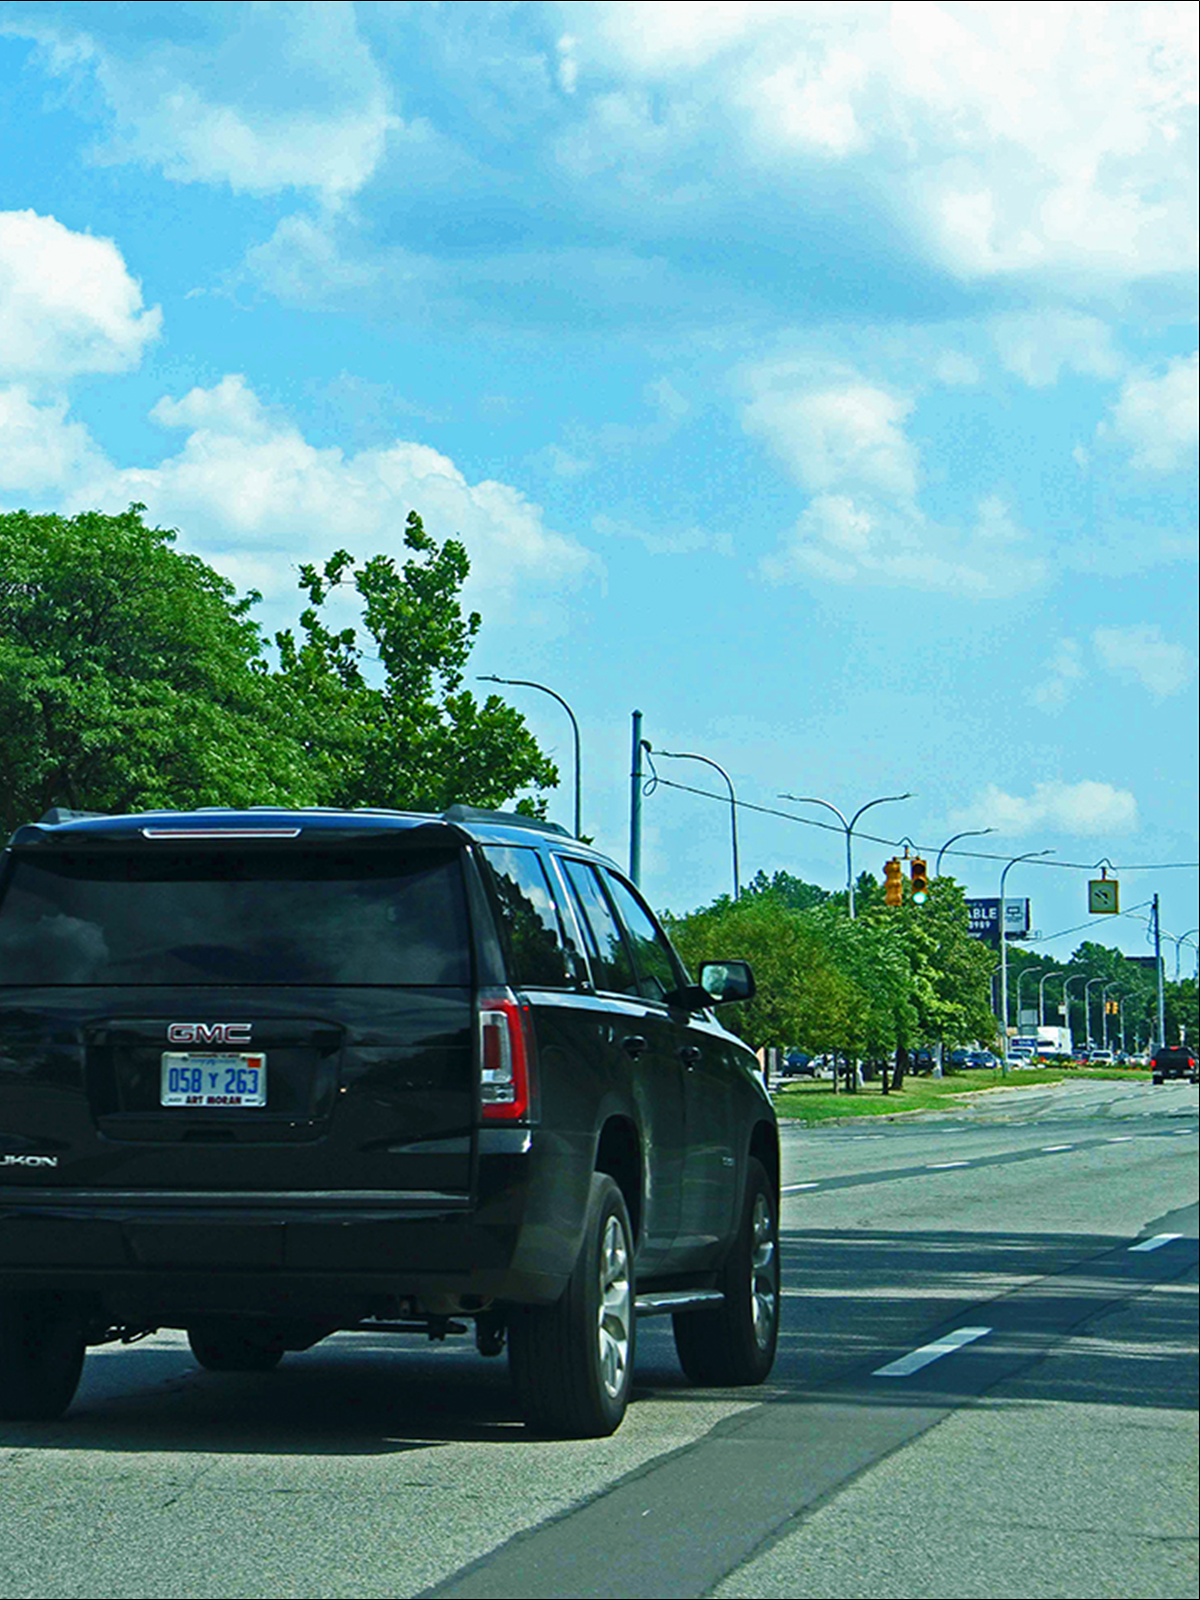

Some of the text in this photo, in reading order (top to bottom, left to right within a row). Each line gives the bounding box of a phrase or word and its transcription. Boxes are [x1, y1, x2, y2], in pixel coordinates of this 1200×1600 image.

[168, 1023, 252, 1043] GMC
[169, 1068, 259, 1094] 058 Y 263
[186, 1096, 204, 1105] ART
